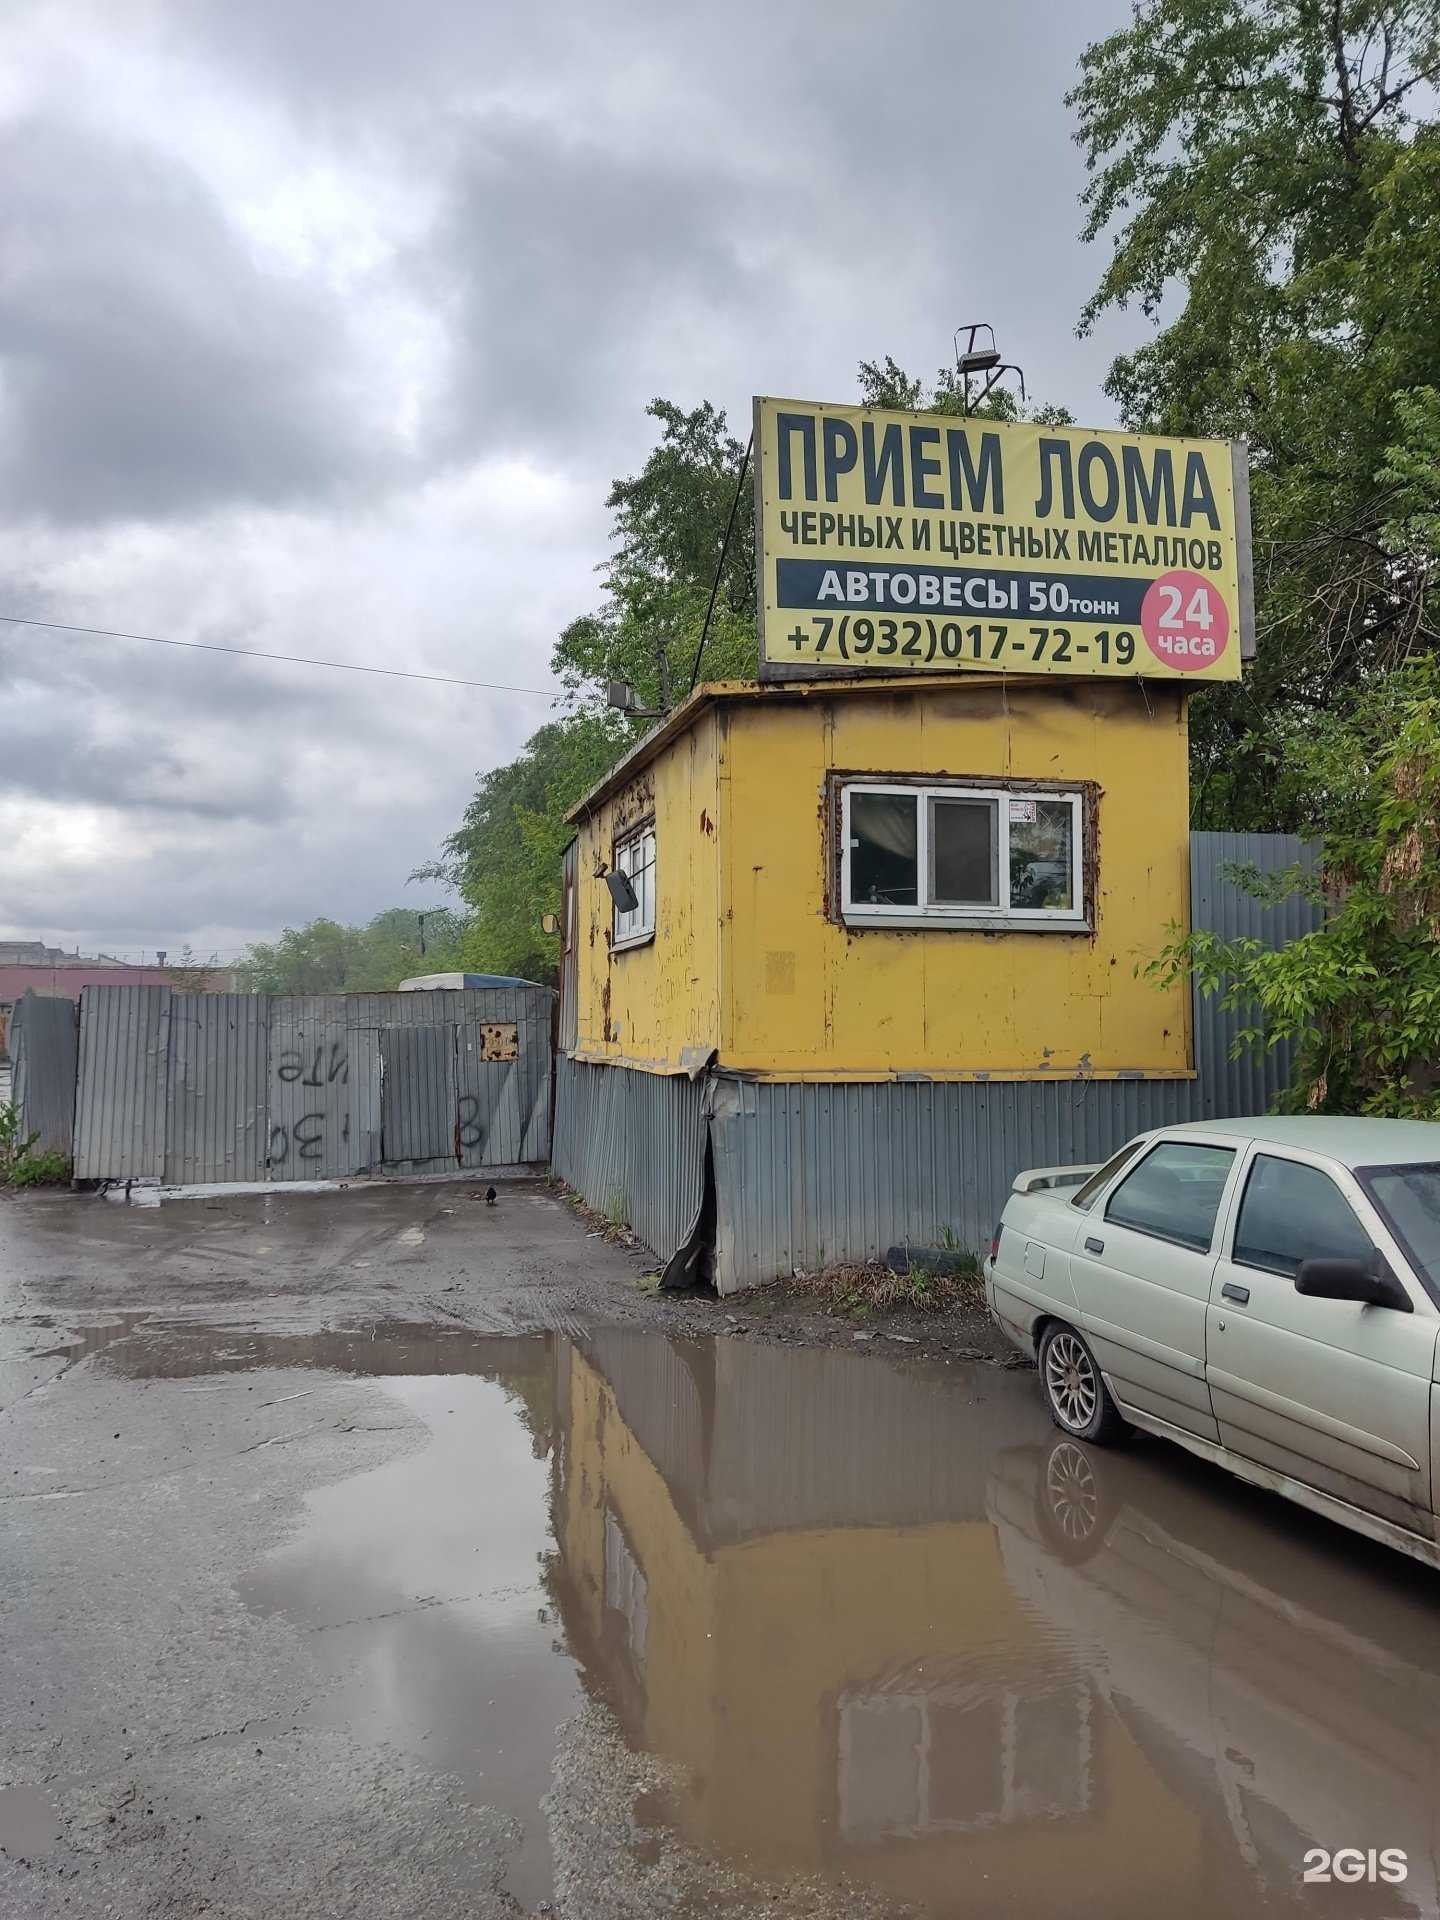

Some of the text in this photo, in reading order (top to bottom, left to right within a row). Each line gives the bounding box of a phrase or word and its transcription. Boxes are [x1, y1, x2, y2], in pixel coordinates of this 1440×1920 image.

[777, 412, 1222, 531] ПРИЕМ ЛОМА
[780, 510, 1223, 571] ЧЕРНЫХ И ЦВЕТНЫХ МЕТАЛЛОВ
[816, 569, 1018, 611] АВТОВЕСЫ
[1158, 585, 1214, 631] 24
[787, 615, 1136, 666] +7(932)017-72-19
[1157, 634, 1216, 657] часа
